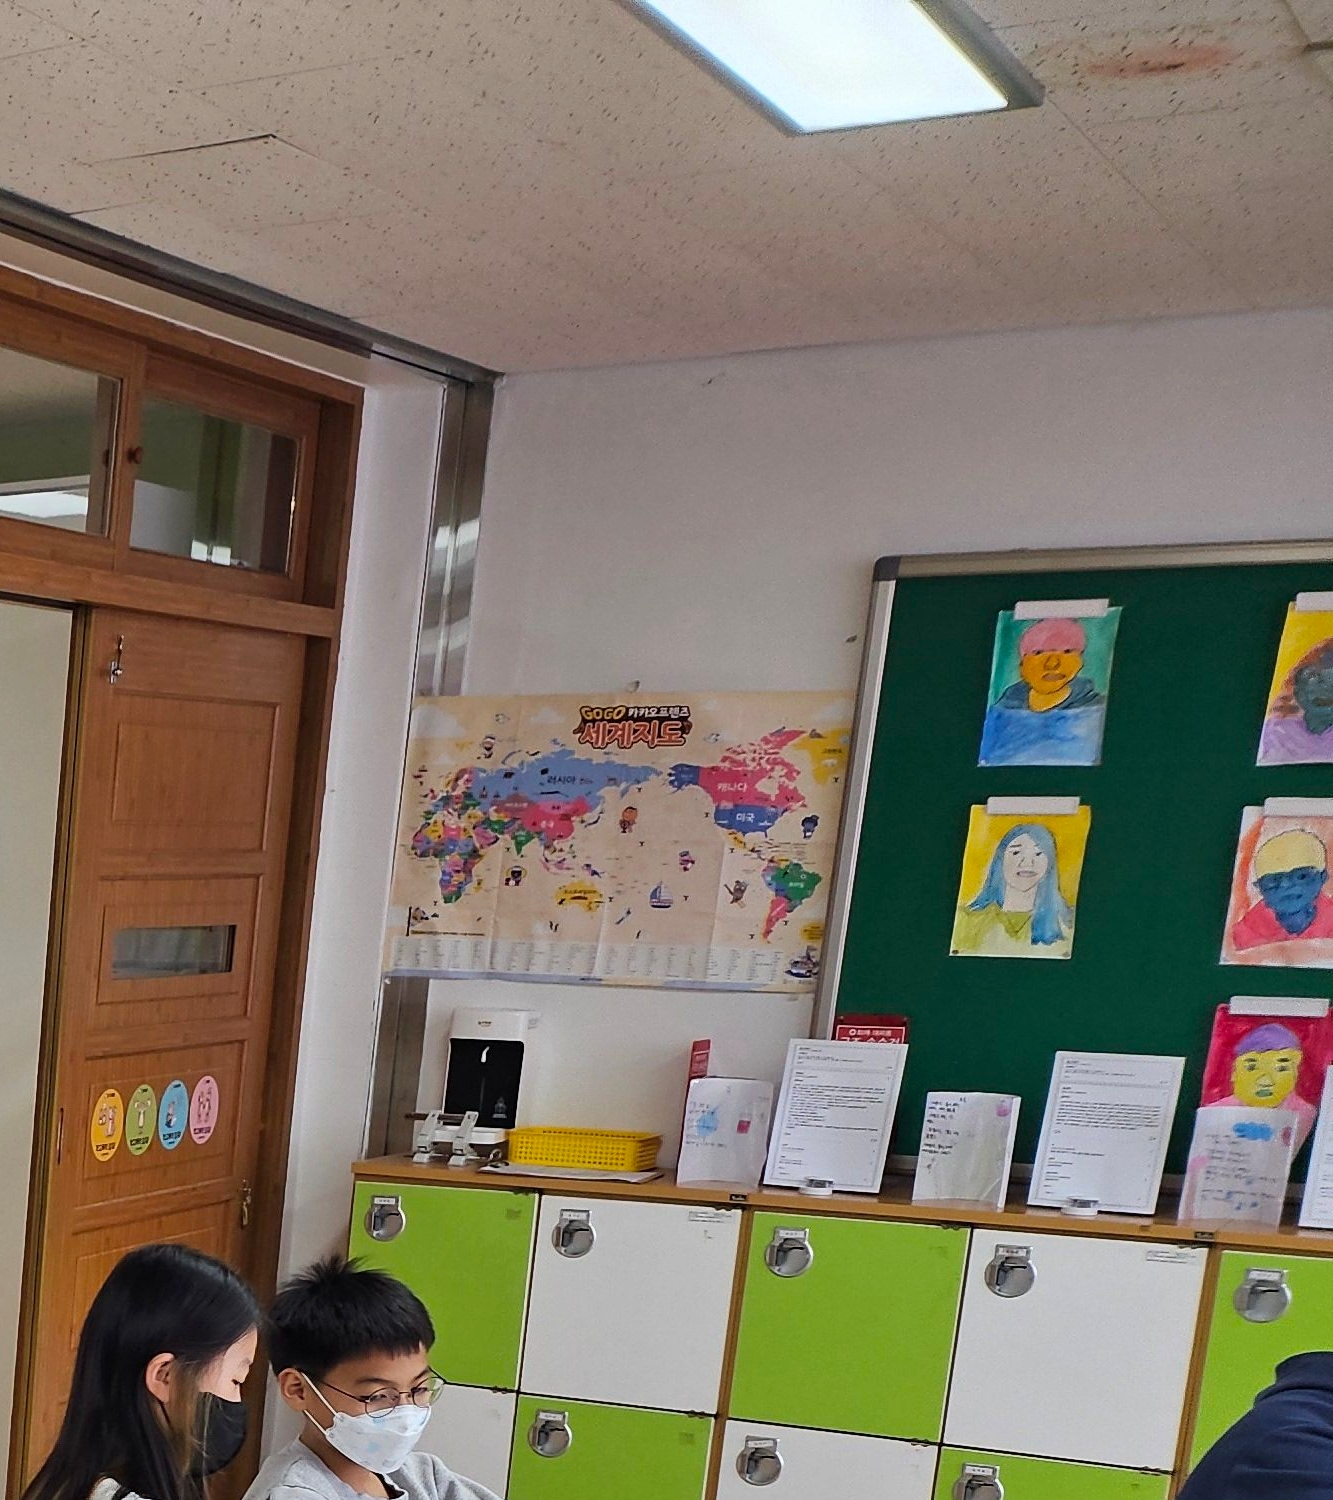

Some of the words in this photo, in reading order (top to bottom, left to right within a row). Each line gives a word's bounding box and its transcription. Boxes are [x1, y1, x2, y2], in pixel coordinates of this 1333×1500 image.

[580, 705, 627, 720] GOGO
[627, 706, 690, 719] 카카오프렌즈
[578, 720, 686, 749] 세계지도
[546, 775, 576, 785] 러시아
[717, 782, 748, 793] 캐나다
[735, 812, 756, 824] 미국
